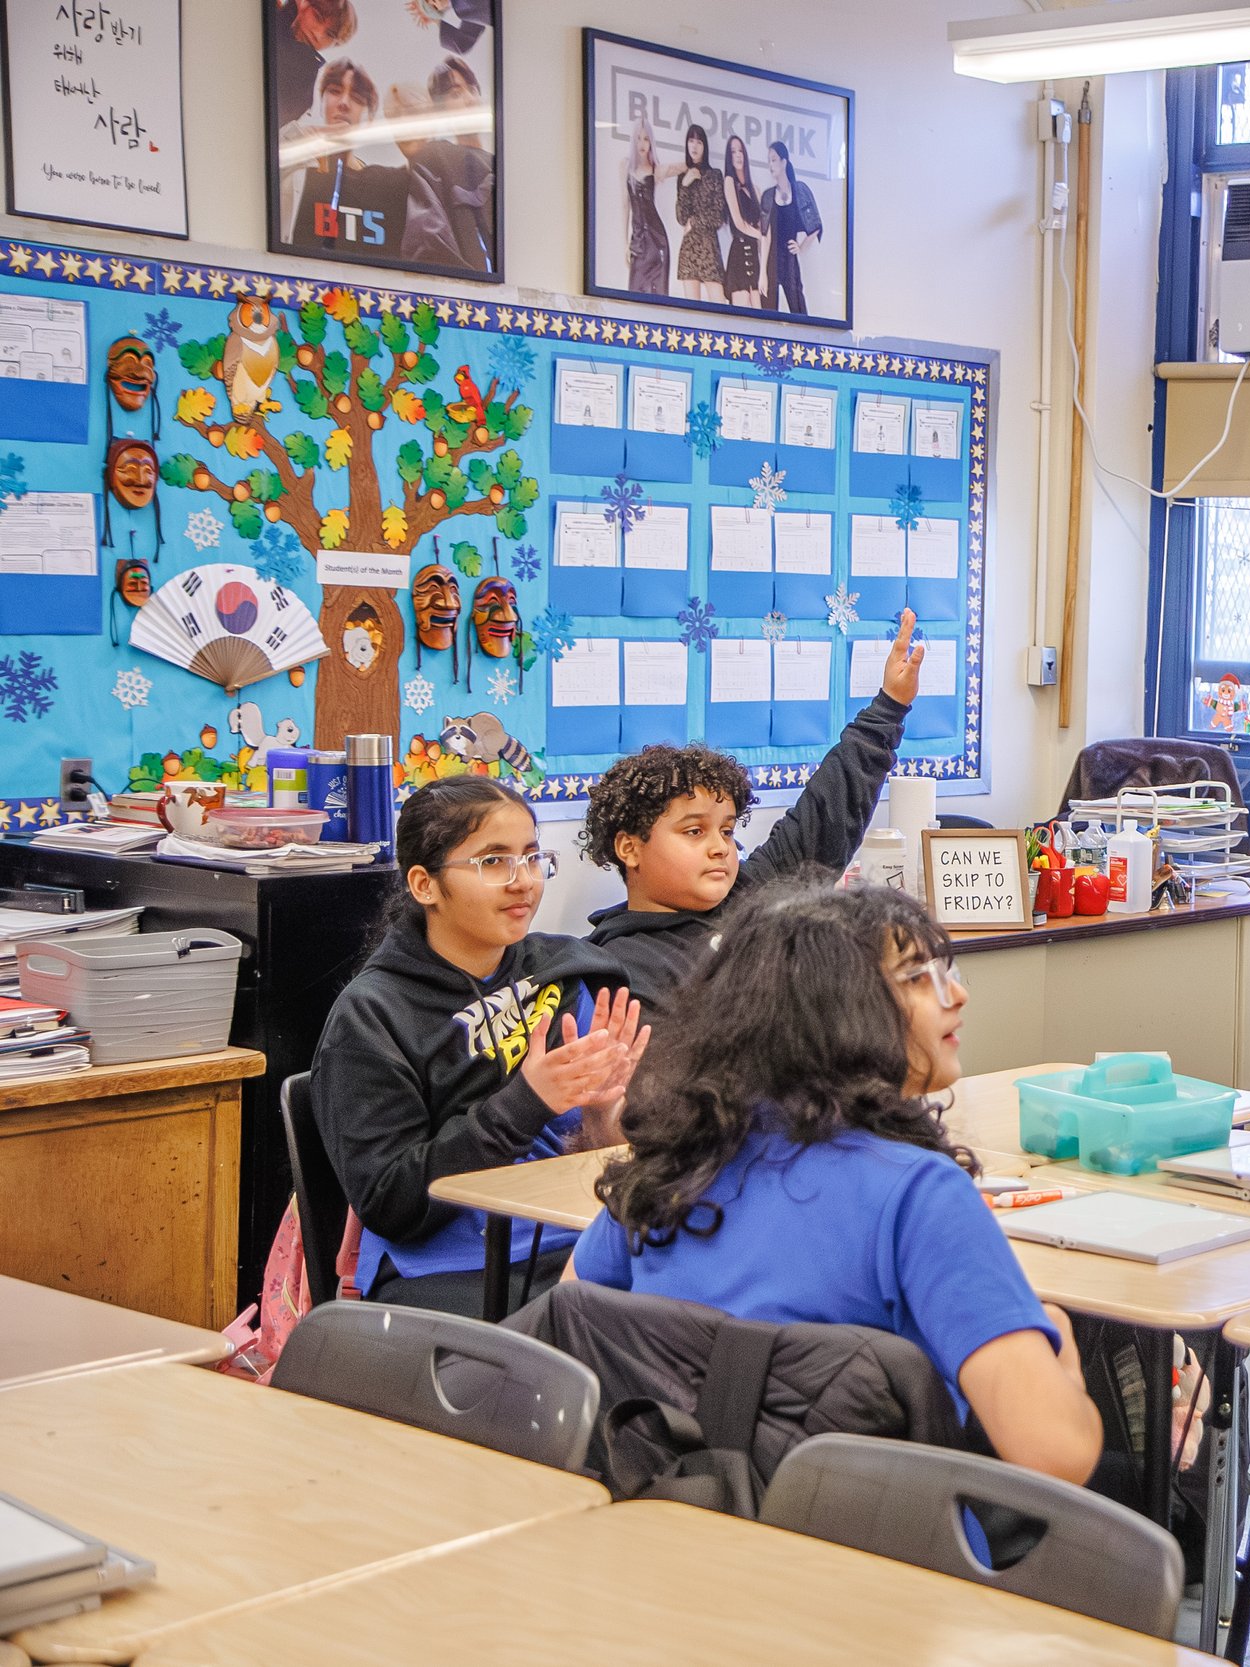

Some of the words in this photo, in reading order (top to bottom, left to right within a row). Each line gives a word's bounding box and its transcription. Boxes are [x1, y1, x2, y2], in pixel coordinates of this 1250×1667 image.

[53, 44, 82, 65] 위해
[54, 74, 101, 104] 태어난
[94, 106, 147, 149] 사람
[313, 202, 386, 245] BTS
[368, 567, 380, 575] the
[381, 568, 403, 576] Month
[940, 851, 972, 865] CAN
[978, 851, 1002, 865] WE
[942, 873, 979, 888] SKIP
[985, 873, 1004, 887] TO
[944, 895, 1013, 911] FRIDAY?
